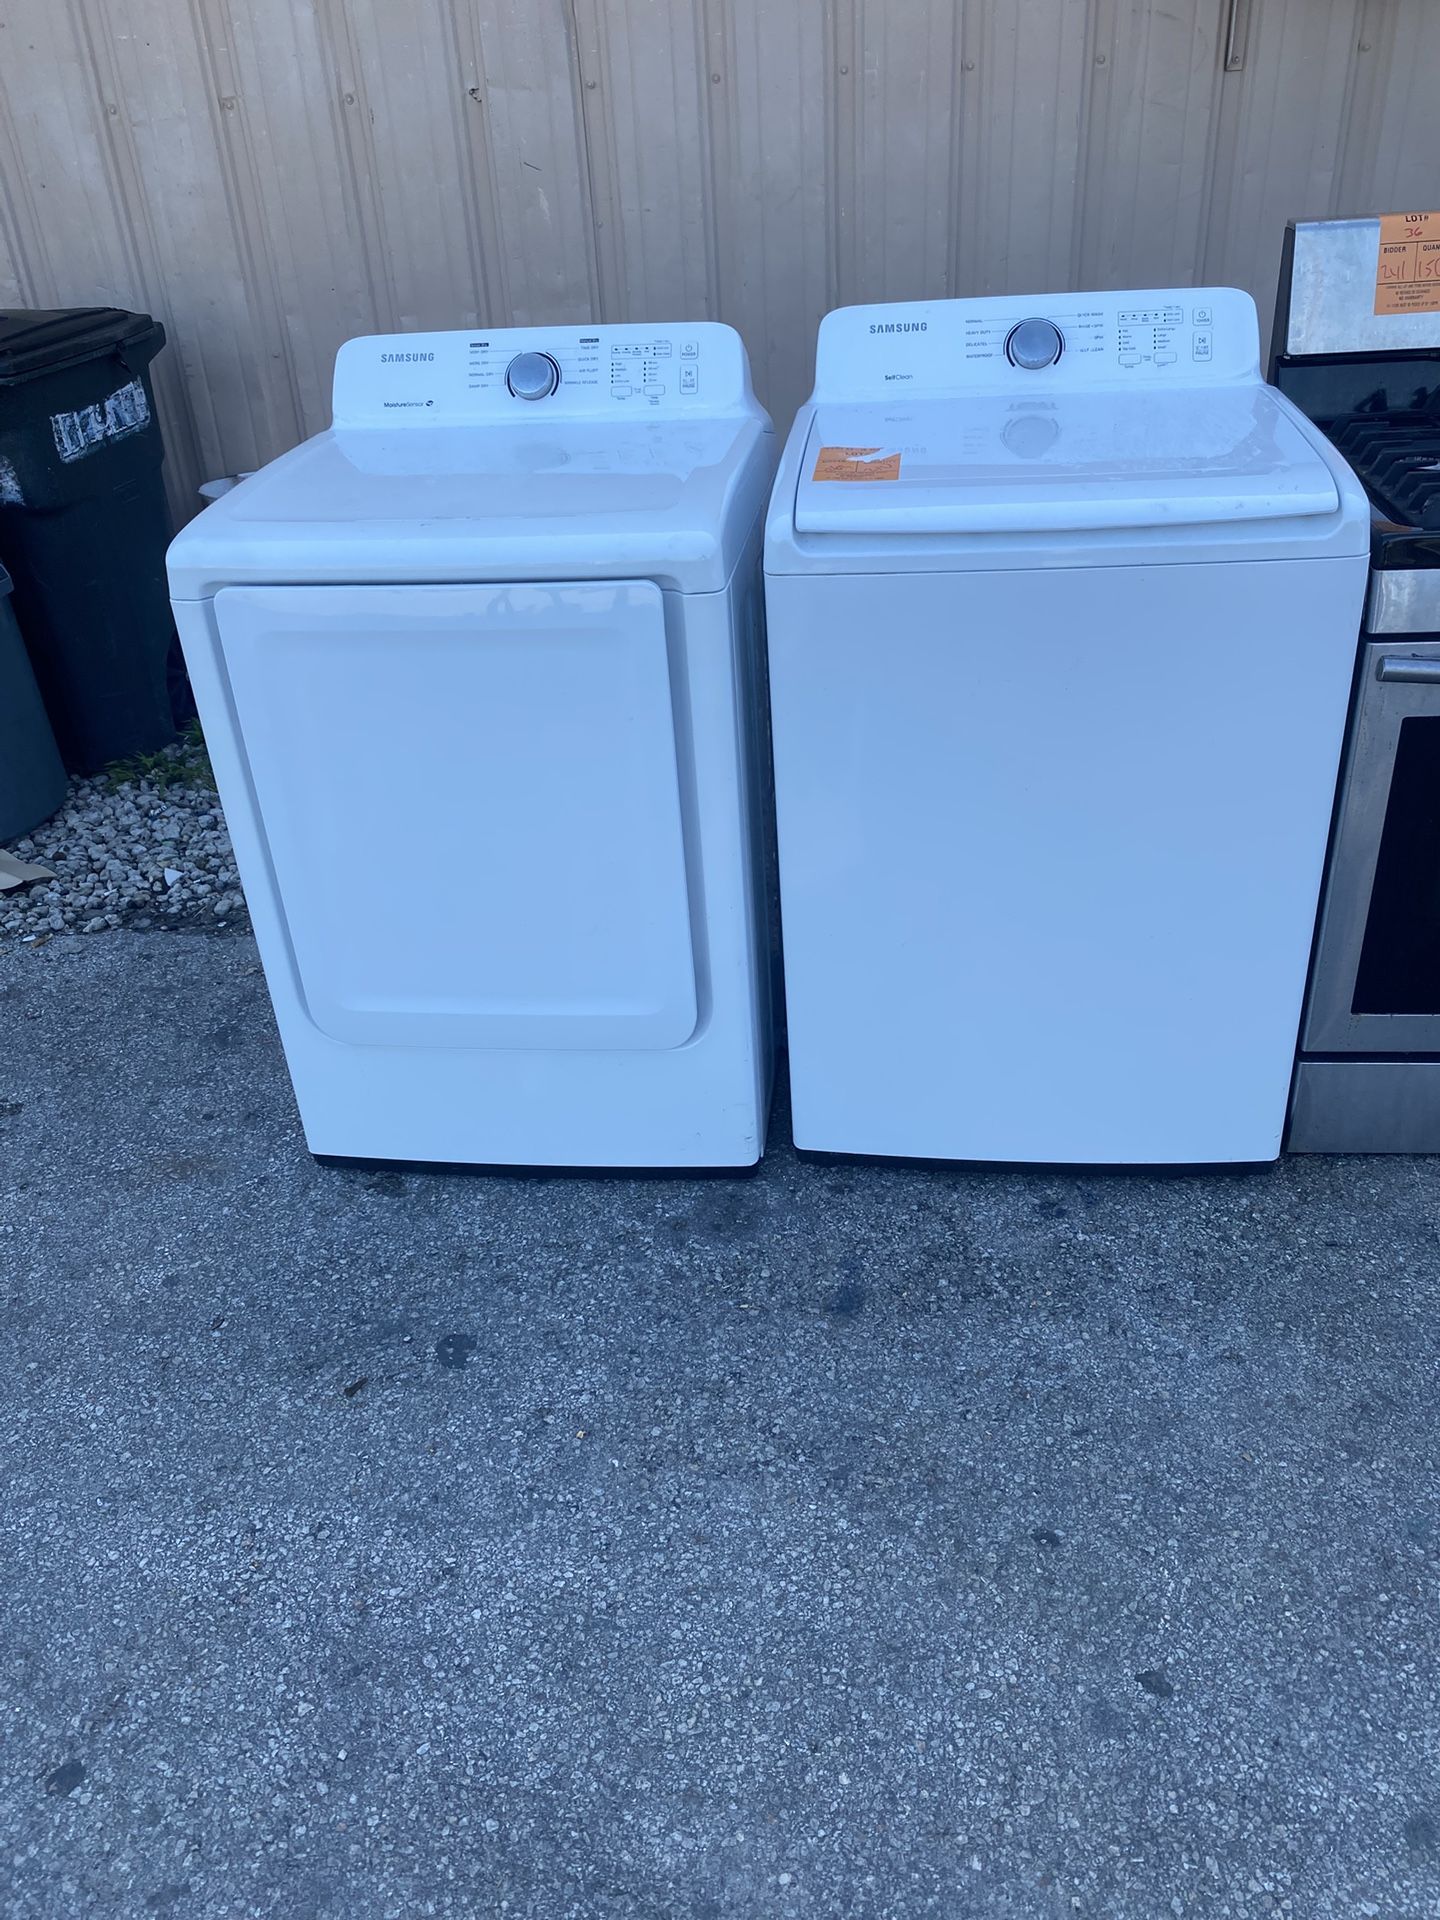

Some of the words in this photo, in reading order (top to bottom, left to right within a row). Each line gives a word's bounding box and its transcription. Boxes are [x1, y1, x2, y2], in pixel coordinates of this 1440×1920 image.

[1404, 227, 1423, 238] 36
[870, 322, 928, 334] SAMSUNG
[381, 352, 434, 363] SAMSUNG
